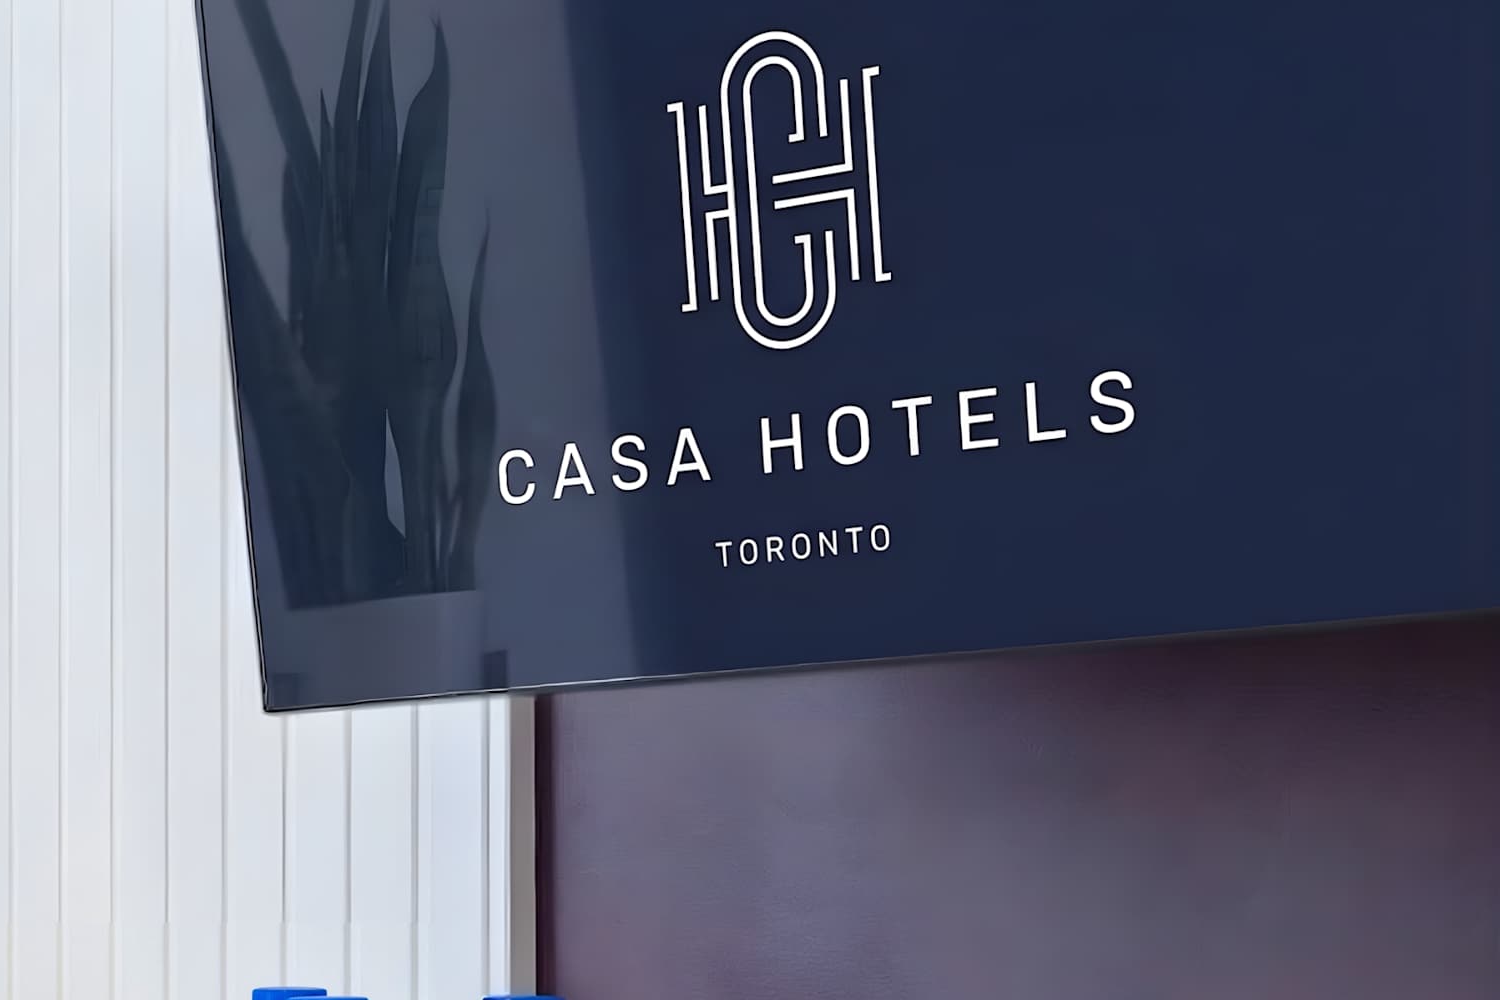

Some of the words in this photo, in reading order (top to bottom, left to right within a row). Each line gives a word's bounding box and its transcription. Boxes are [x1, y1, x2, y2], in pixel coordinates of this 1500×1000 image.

[498, 428, 711, 505] CASA
[761, 370, 1136, 474] HOTELS
[715, 524, 891, 567] TORONTO
